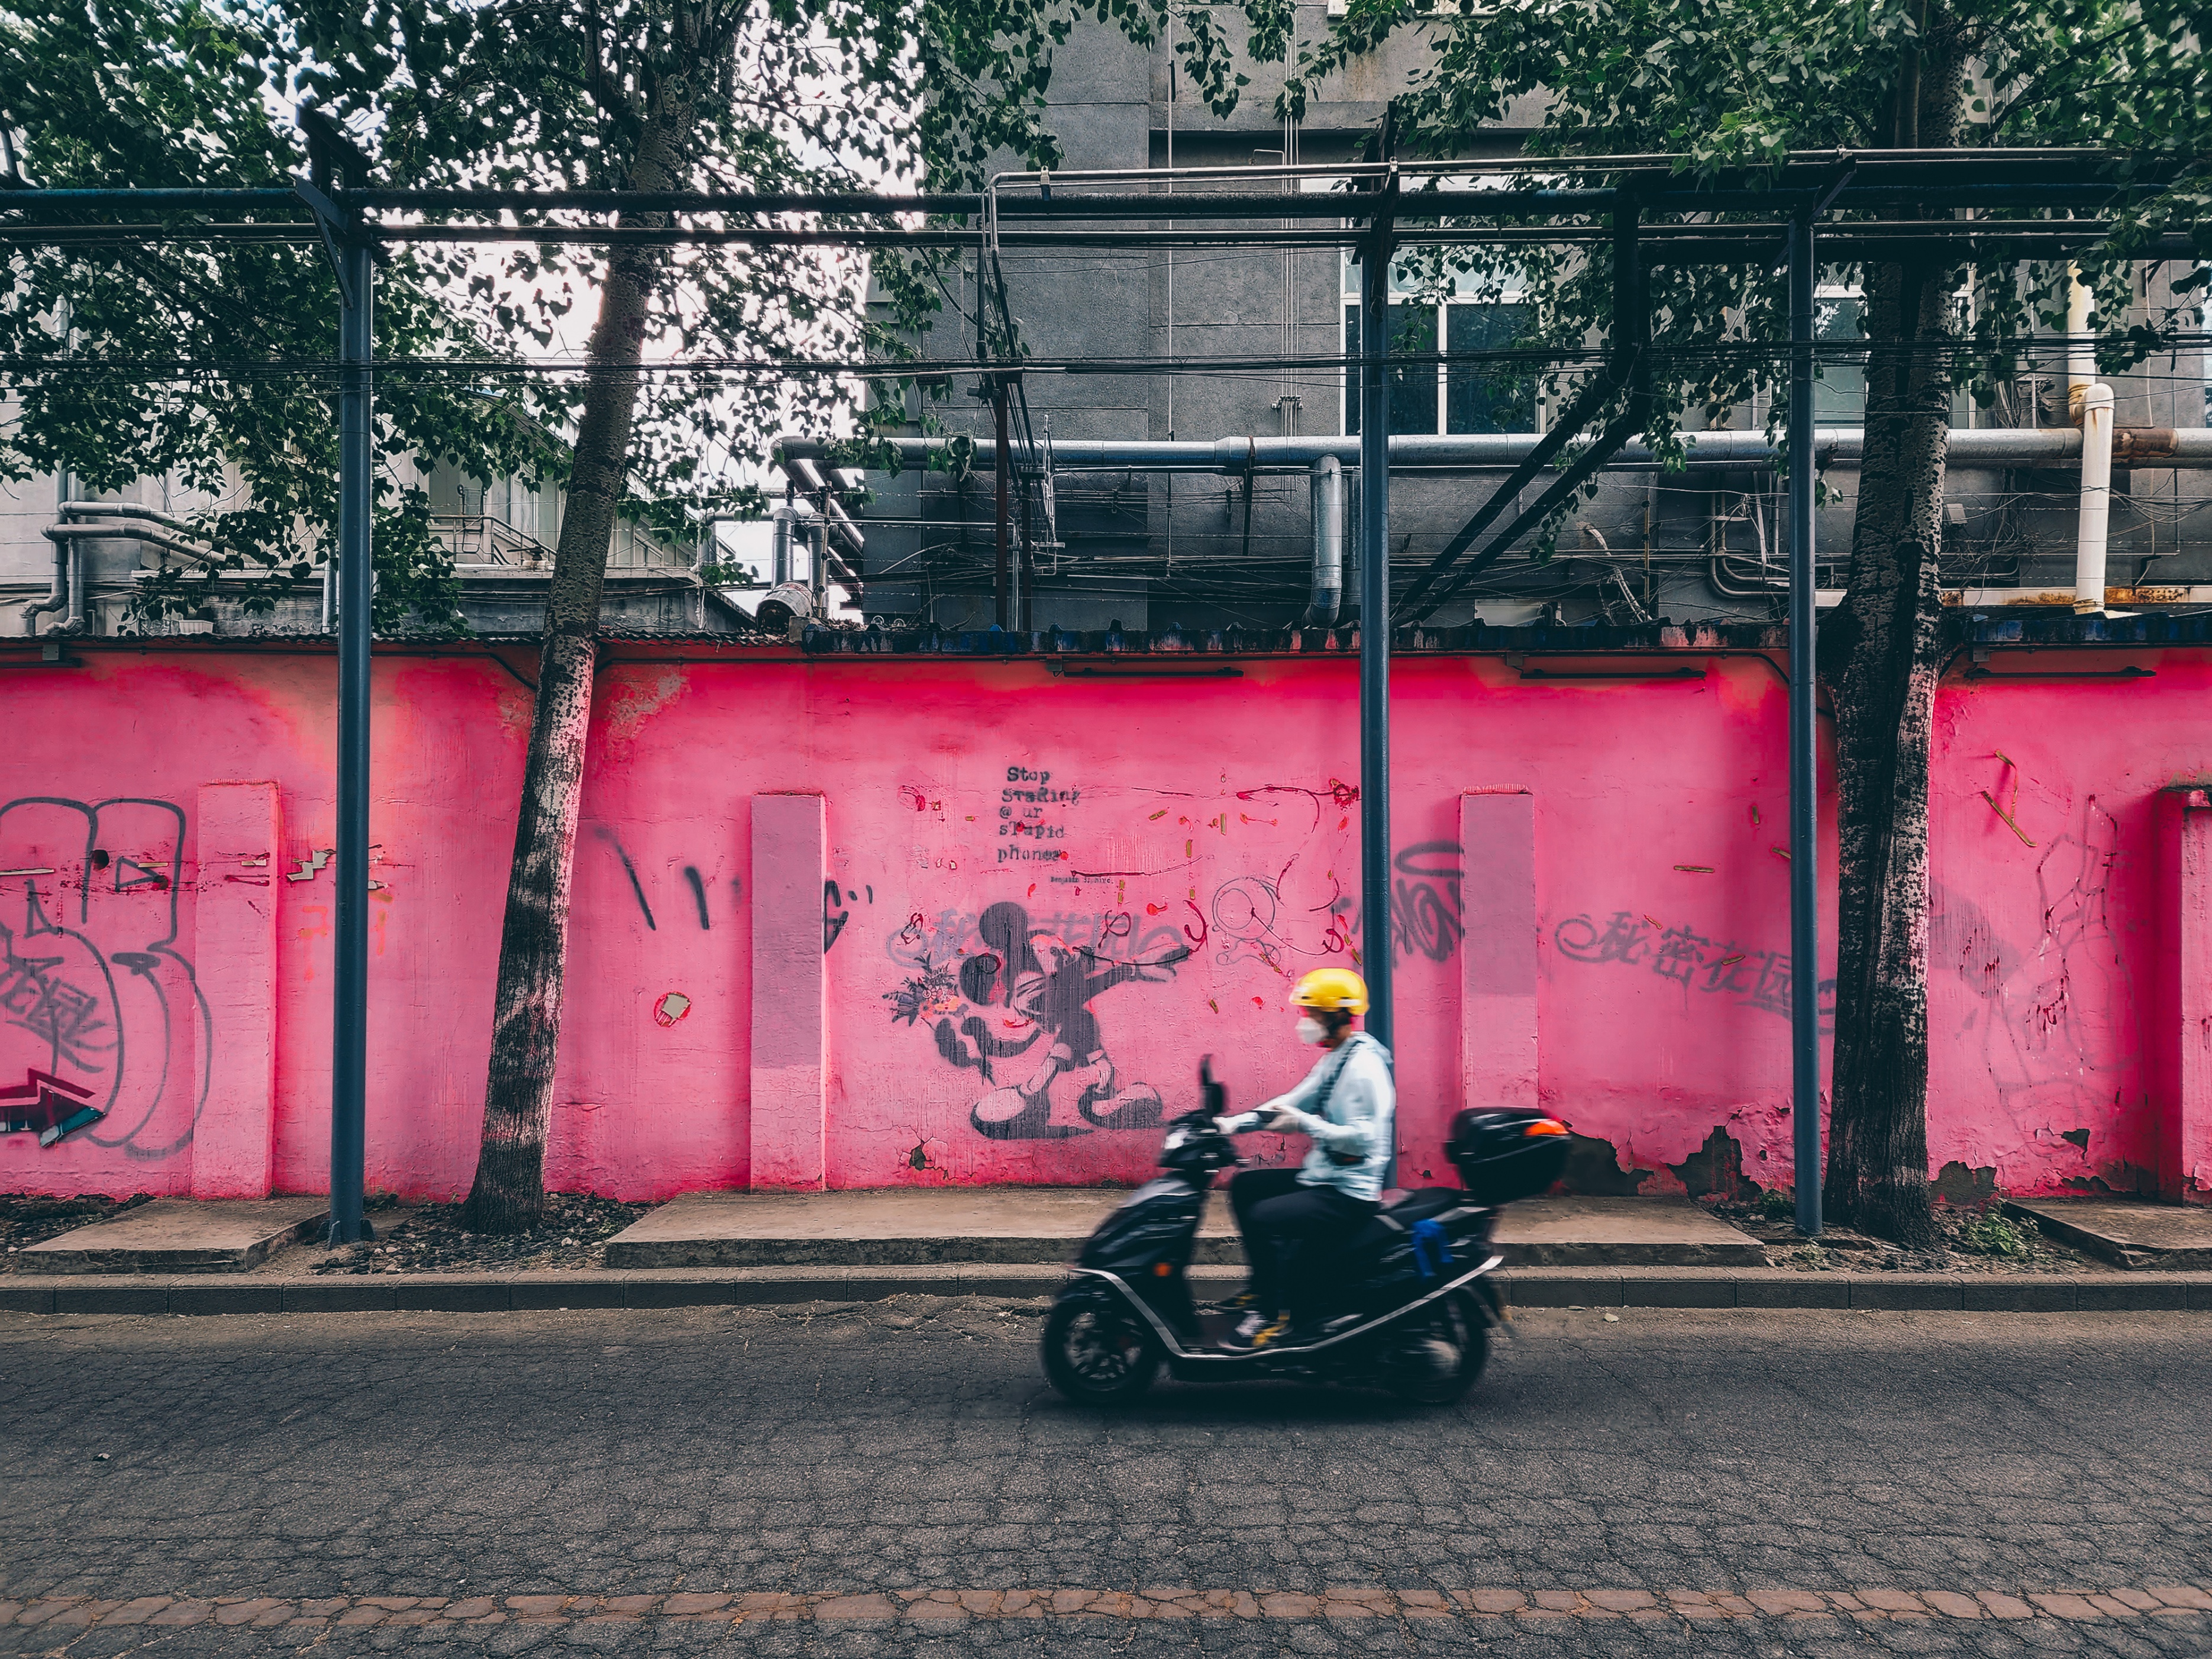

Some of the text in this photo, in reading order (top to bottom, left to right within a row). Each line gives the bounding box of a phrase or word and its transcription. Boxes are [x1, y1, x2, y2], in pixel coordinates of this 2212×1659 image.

[1007, 767, 1050, 785] Stop
[999, 806, 1043, 819] @ ur
